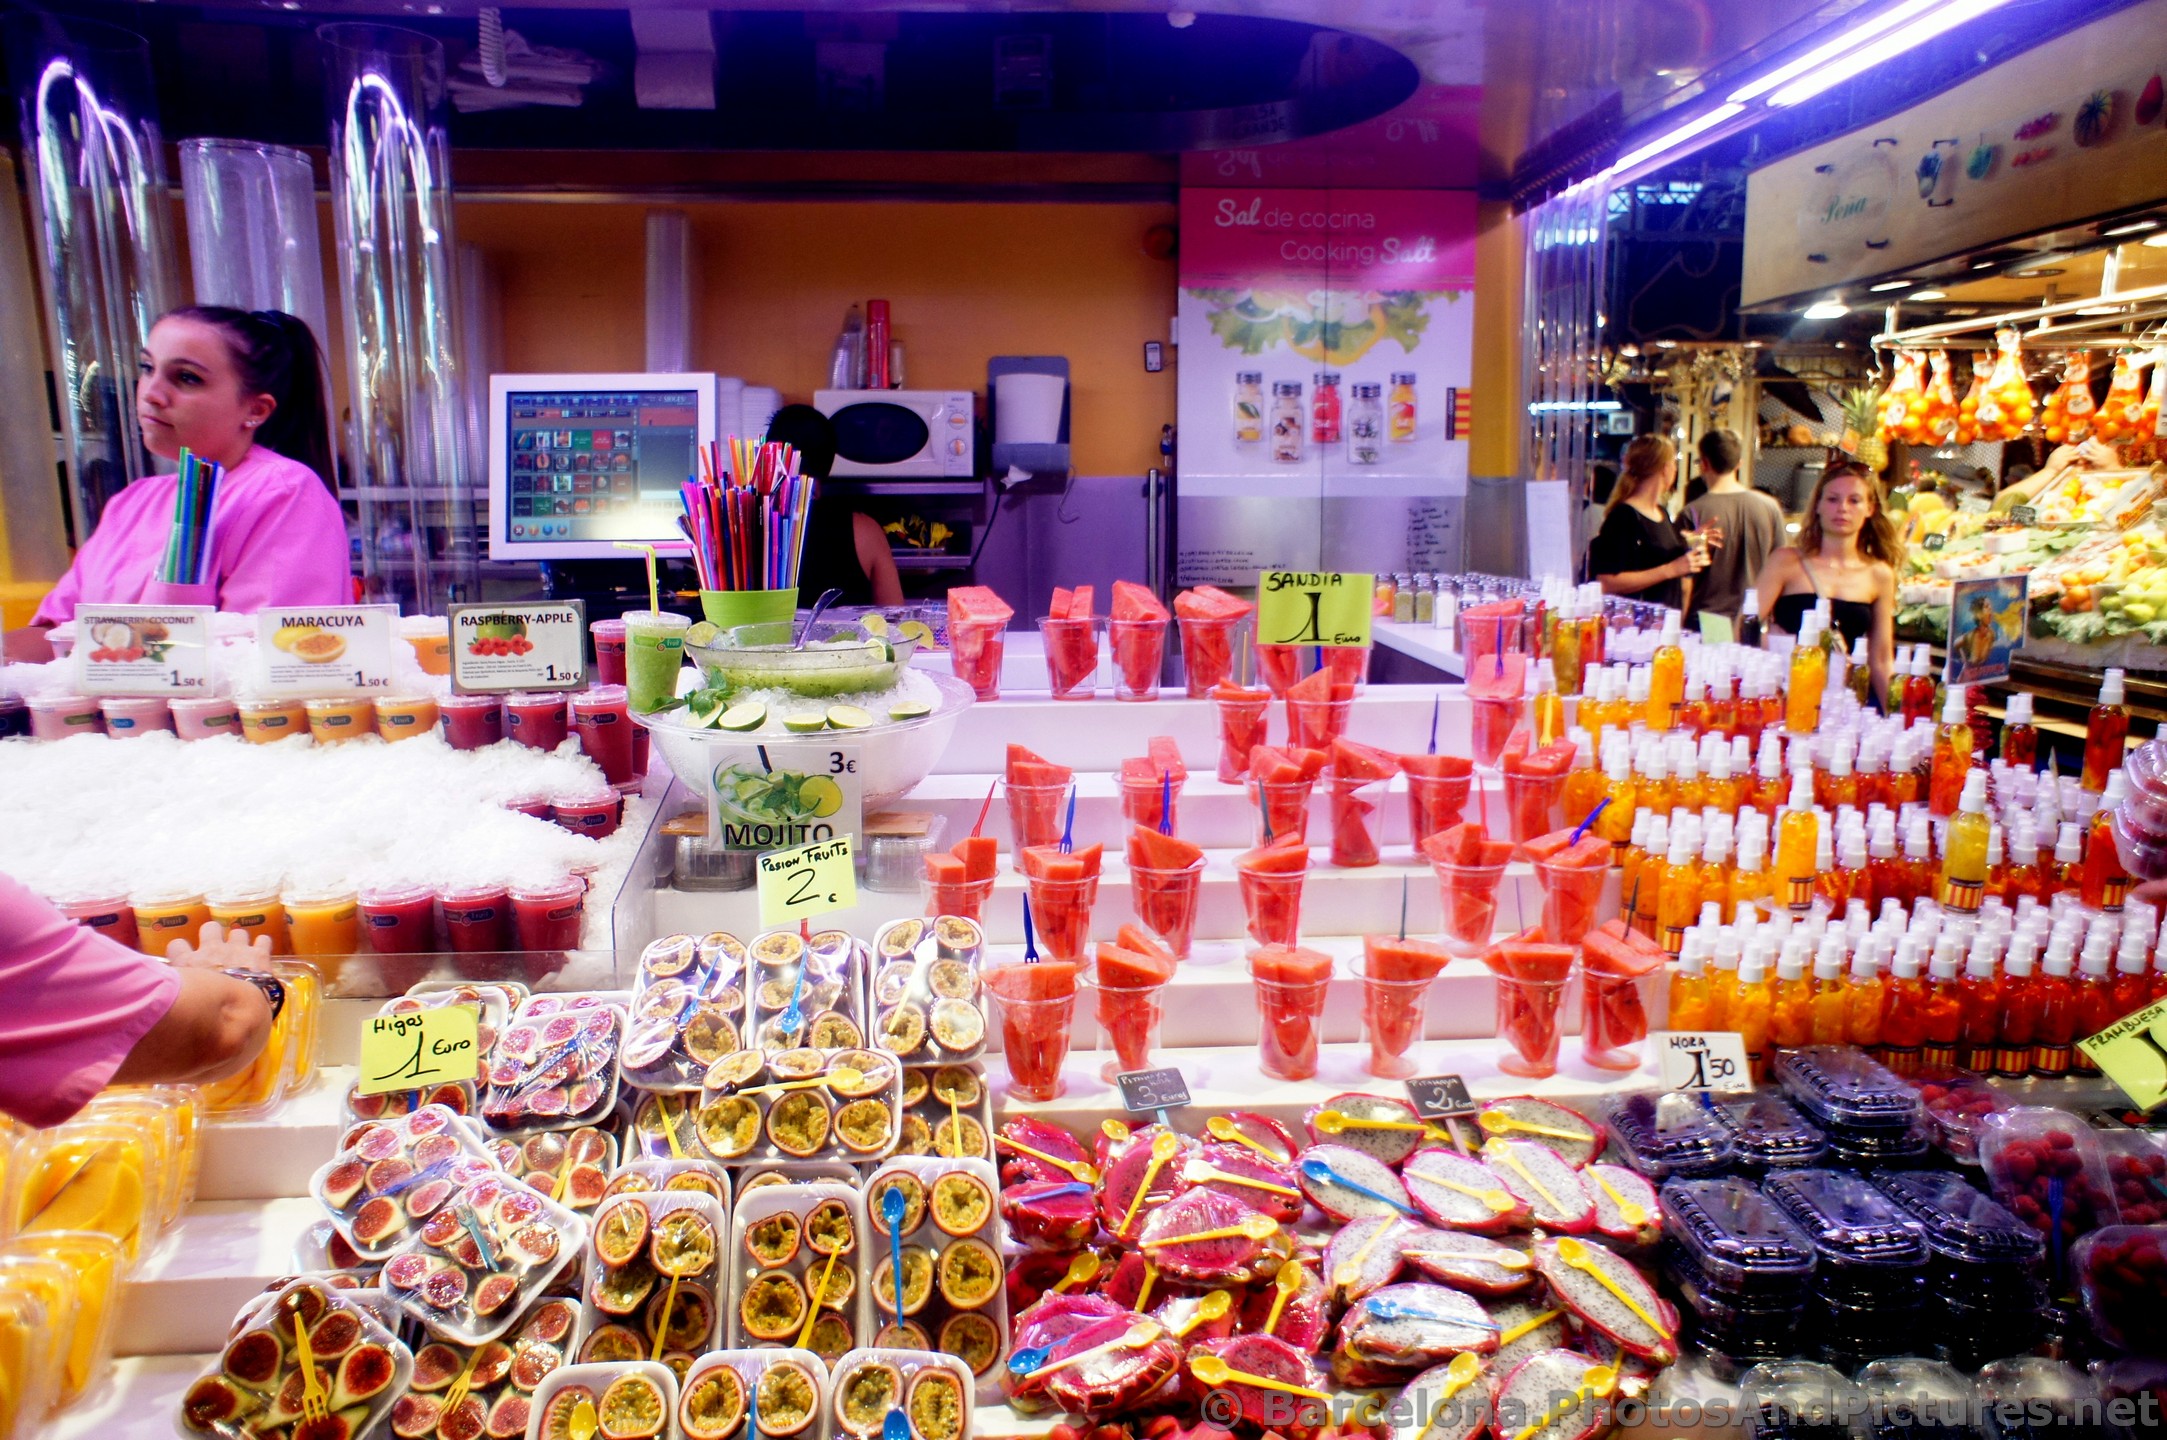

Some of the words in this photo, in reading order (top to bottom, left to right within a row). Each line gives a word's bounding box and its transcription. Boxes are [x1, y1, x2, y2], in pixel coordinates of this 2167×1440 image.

[1214, 198, 1262, 227] Sal
[1263, 209, 1294, 228] de
[1298, 209, 1376, 229] cocina
[1280, 240, 1375, 266] Cooking
[1380, 235, 1437, 266] Salt
[84, 616, 195, 625] STRAWBERRY-COCONUT
[281, 615, 365, 628] MARACUYA
[460, 613, 574, 627] RASPBERRY-APPLE
[1275, 592, 1330, 643] 1
[1334, 633, 1361, 645] Euro
[786, 868, 820, 905] 2
[828, 893, 837, 902] €
[2086, 1006, 2165, 1050] FRAMBUESA
[432, 1038, 471, 1056] Euro
[1670, 1036, 1707, 1049] MORA
[372, 1030, 441, 1081] 1
[1136, 1085, 1158, 1107] 3
[1424, 1087, 1454, 1110] 2
